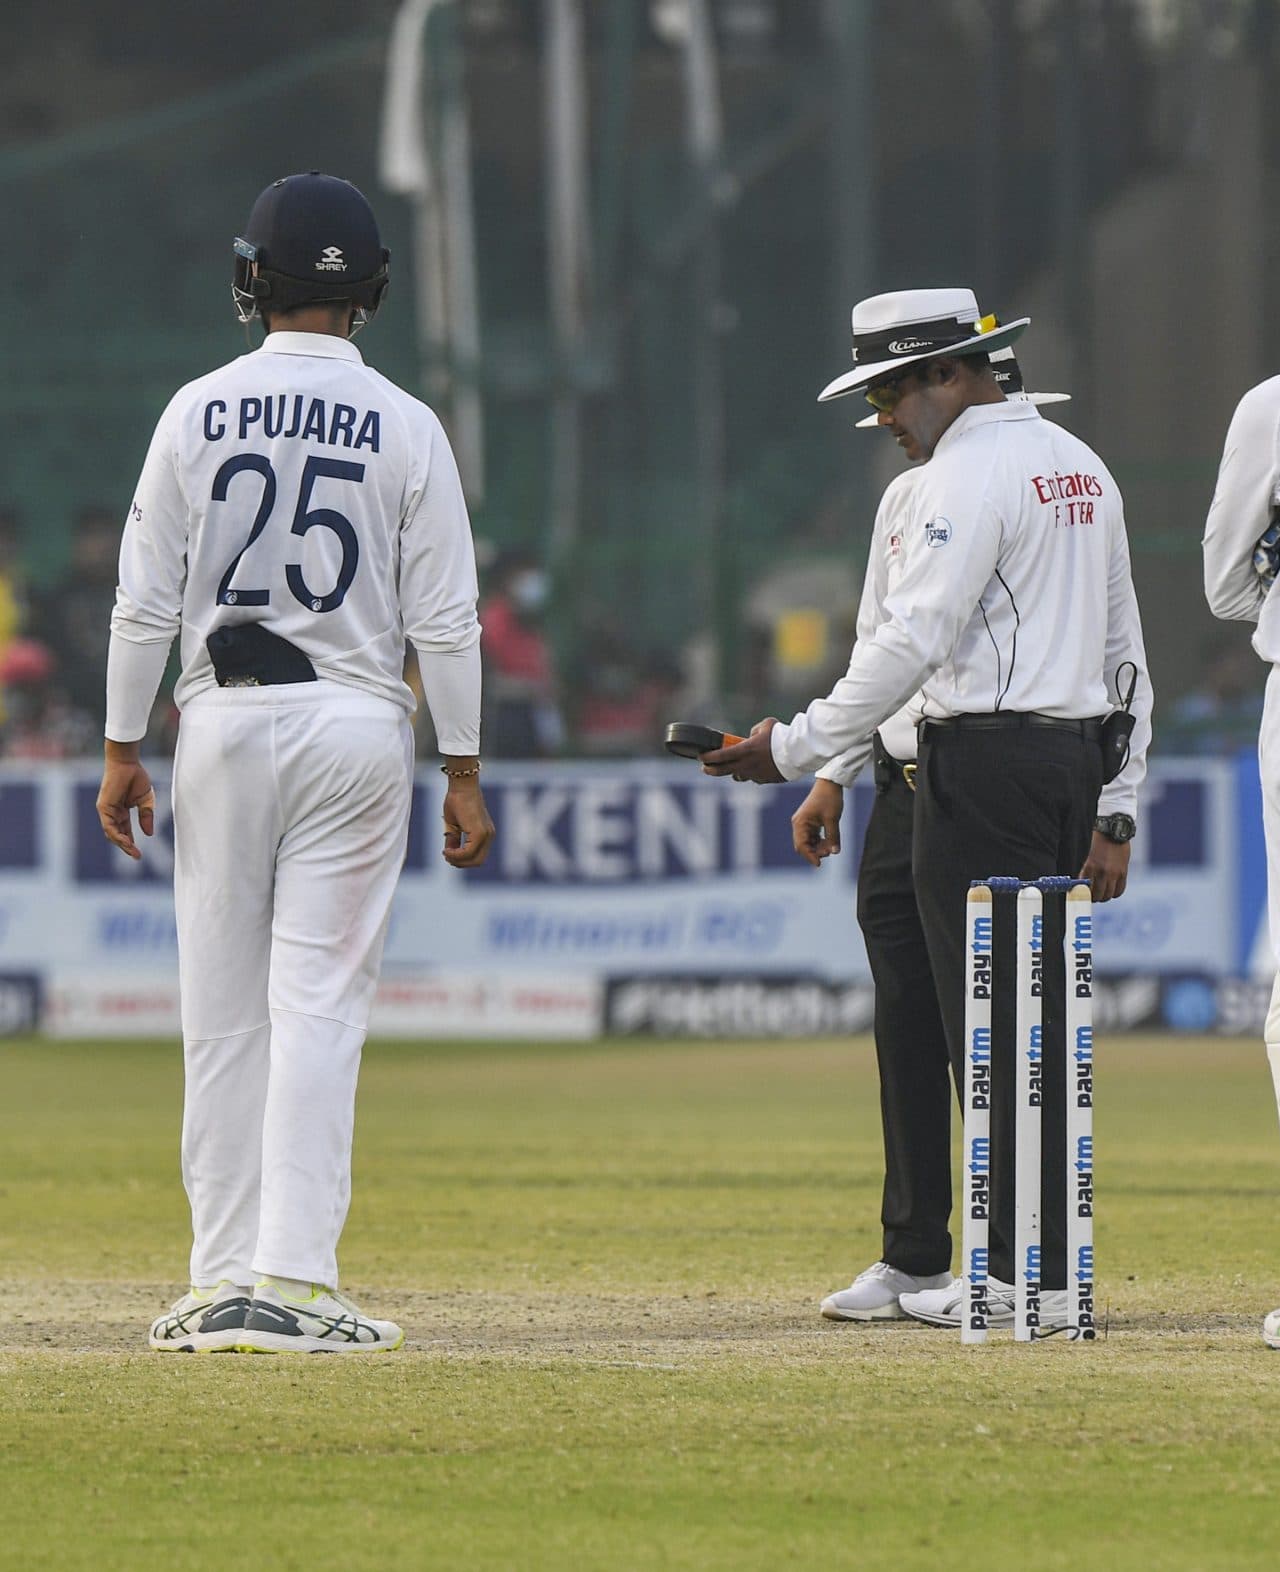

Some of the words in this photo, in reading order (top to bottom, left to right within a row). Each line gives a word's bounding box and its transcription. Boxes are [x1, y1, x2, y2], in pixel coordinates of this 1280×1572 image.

[315, 262, 348, 272] SHREY
[203, 399, 227, 442] C
[239, 394, 381, 454] PUJARA
[210, 452, 367, 613] 25
[502, 777, 778, 881] KENT
[971, 916, 993, 1000] paytm
[1026, 914, 1043, 998] paytm
[1069, 915, 1092, 999] paytm
[970, 1026, 991, 1110] paytm
[1024, 1024, 1042, 1107] paytm
[1071, 1025, 1093, 1108] paytm
[967, 1136, 990, 1220] paytm
[1073, 1135, 1093, 1218] paytm
[966, 1247, 989, 1331] paytm
[1021, 1244, 1041, 1327] paytm
[1073, 1245, 1094, 1328] paytm
